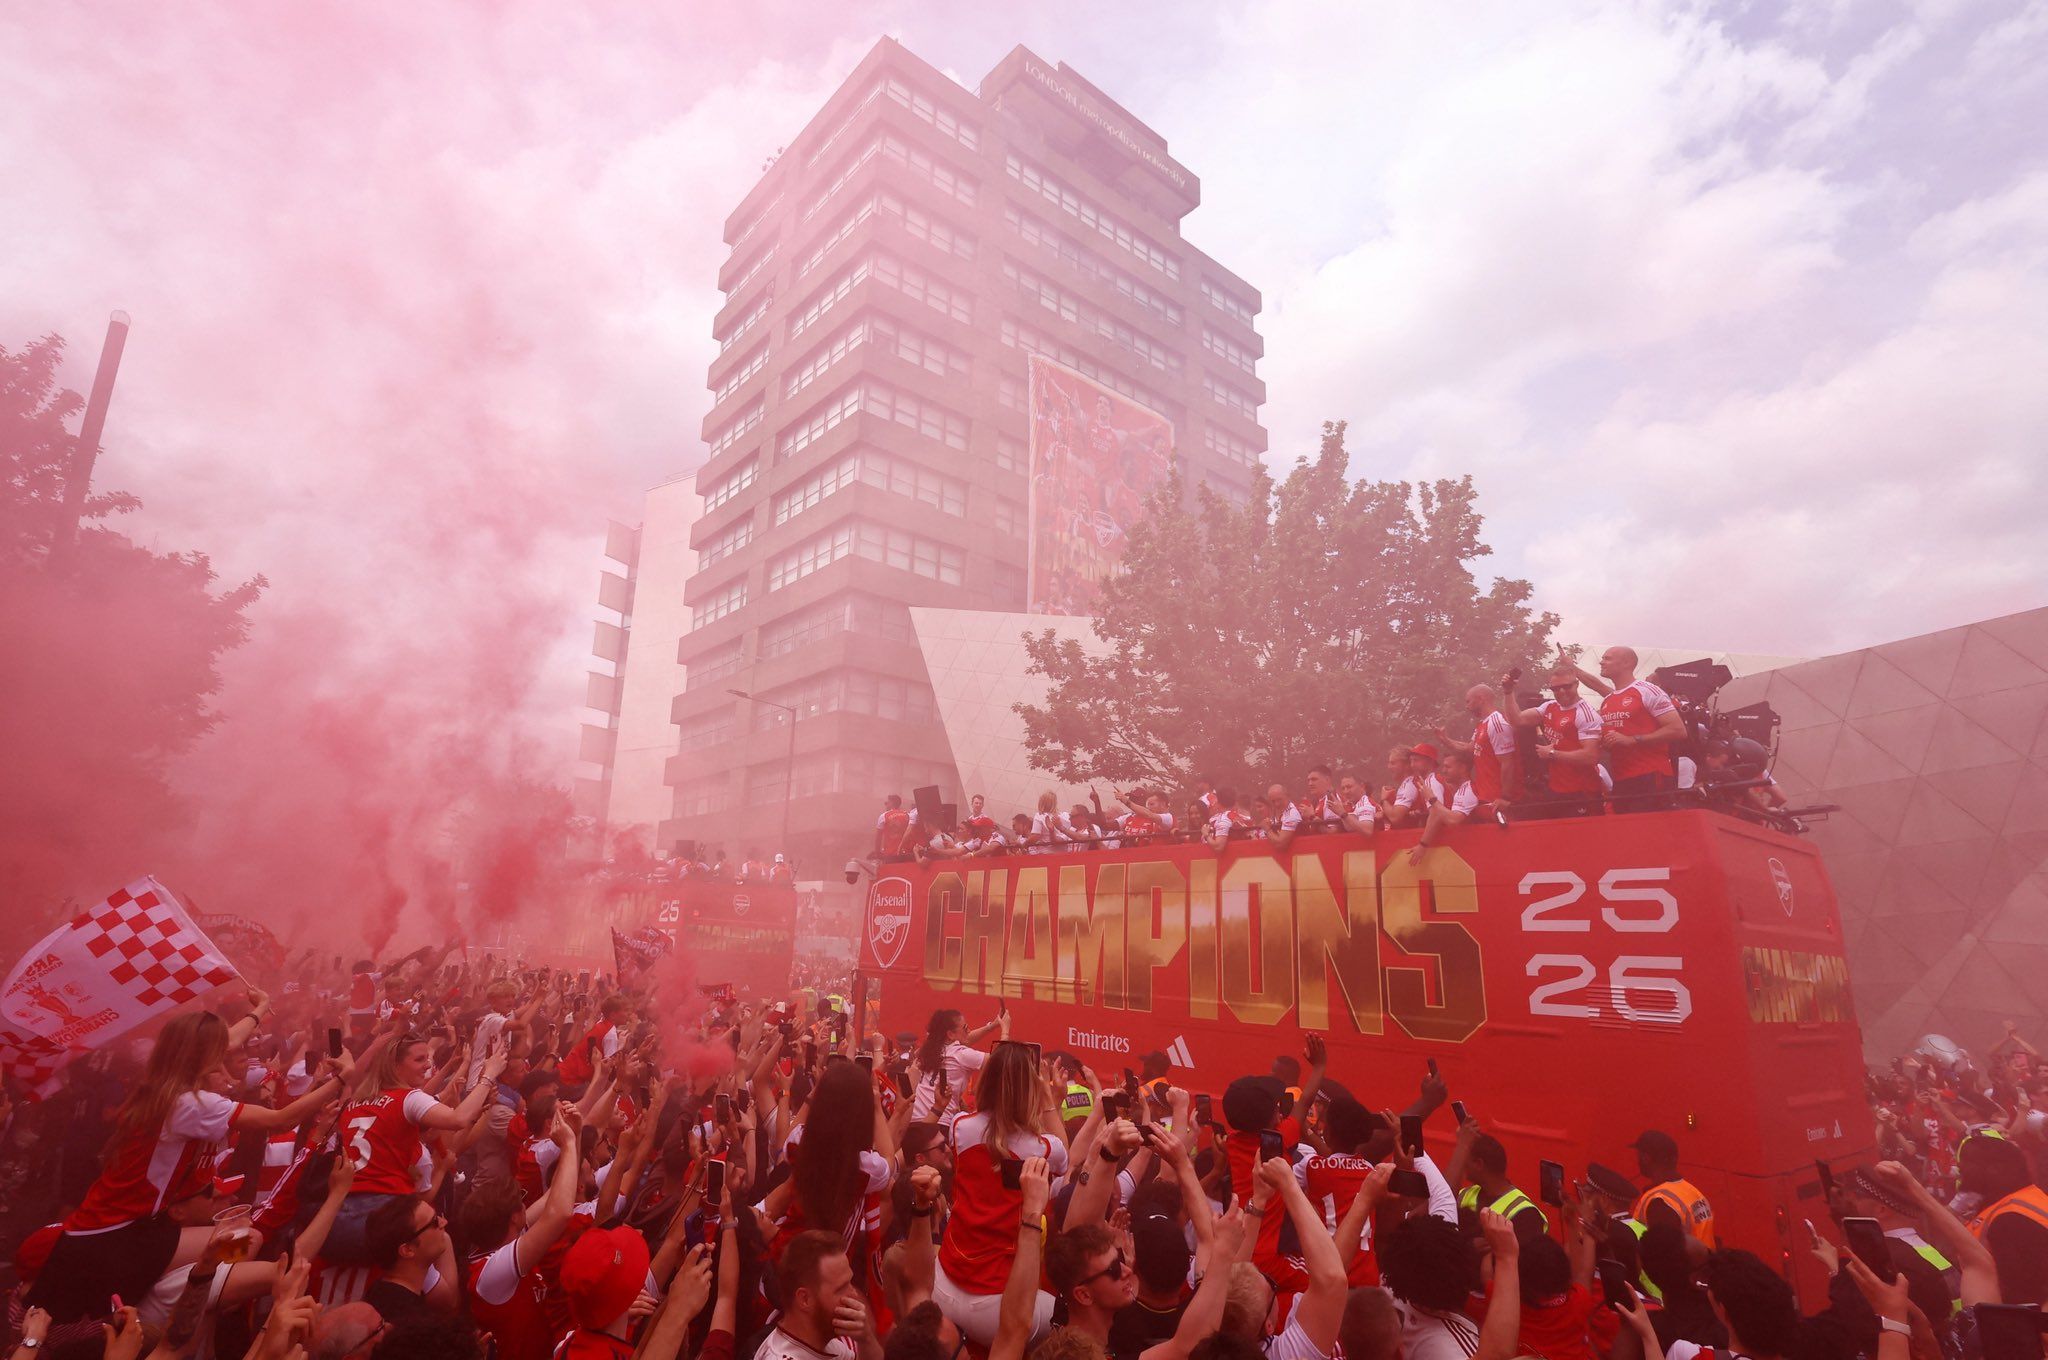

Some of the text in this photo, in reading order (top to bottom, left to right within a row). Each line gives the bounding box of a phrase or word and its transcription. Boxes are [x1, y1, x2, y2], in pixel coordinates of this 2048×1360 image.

[1025, 61, 1186, 188] LONDON metropolitan university
[658, 900, 680, 923] 25
[875, 893, 906, 907] Arsenal
[1518, 867, 1680, 933] 25
[923, 846, 1488, 1044] CHAMPIONS
[1525, 953, 1693, 1024] 26
[1068, 1027, 1130, 1053] Emirates
[1066, 1094, 1090, 1107] POLICE
[347, 1115, 377, 1172] 3
